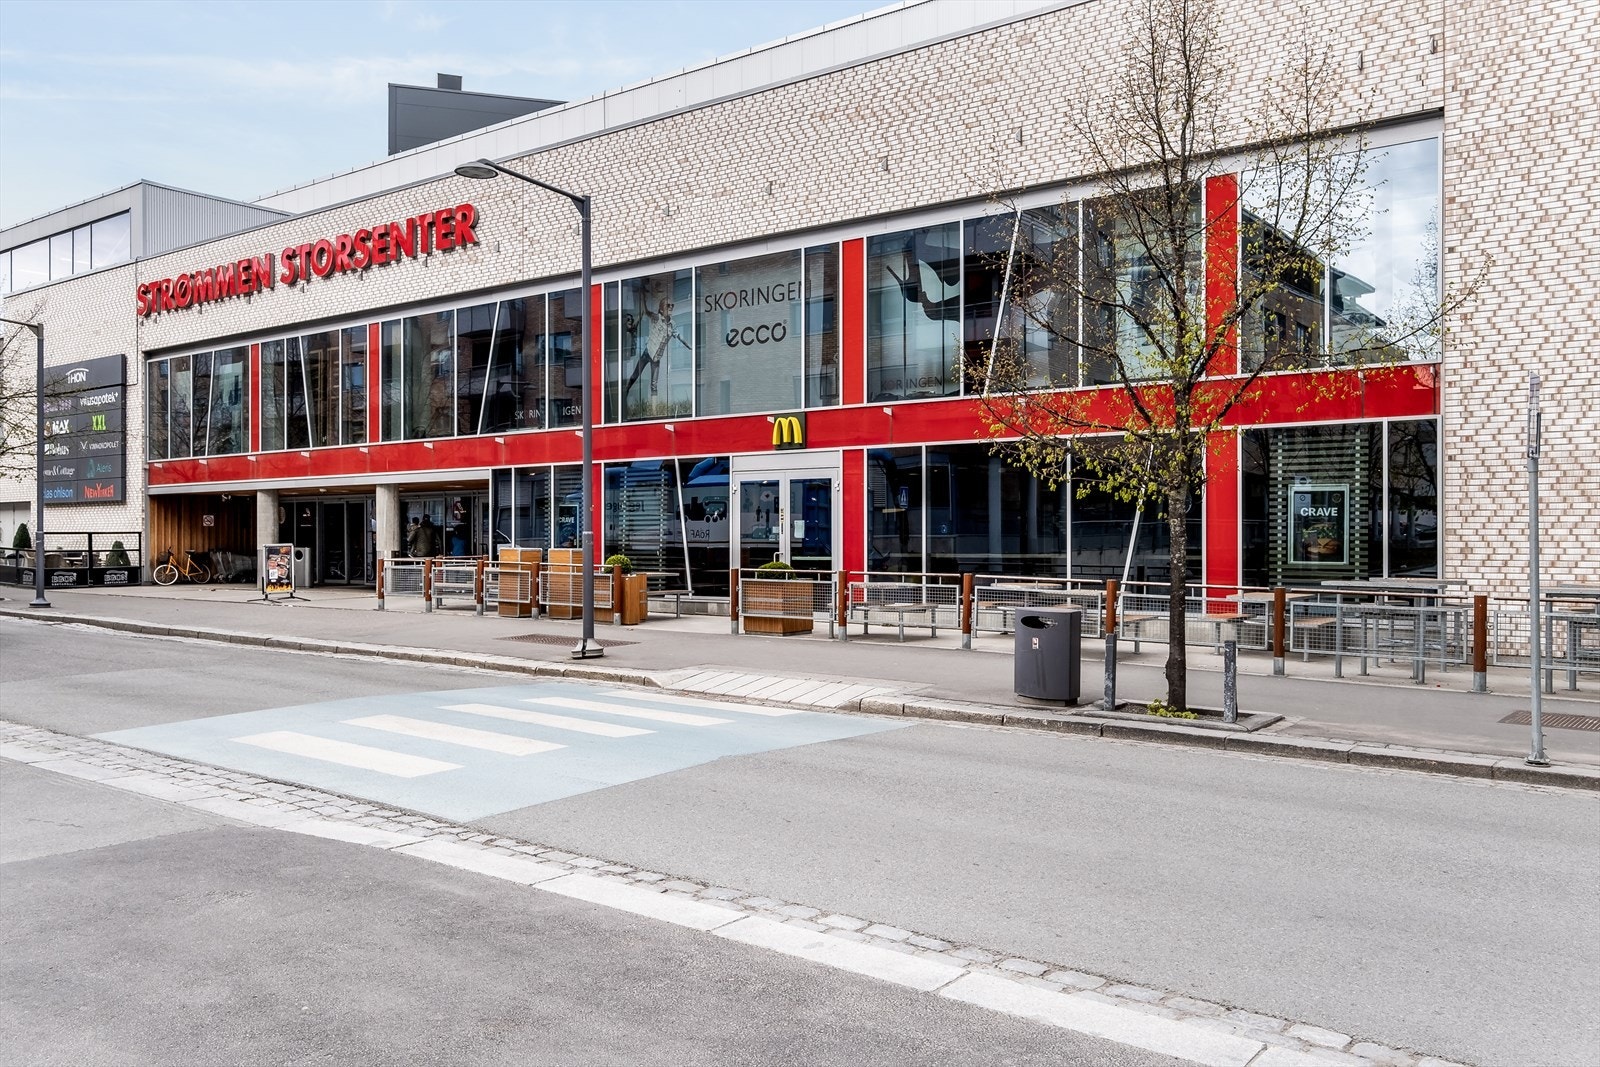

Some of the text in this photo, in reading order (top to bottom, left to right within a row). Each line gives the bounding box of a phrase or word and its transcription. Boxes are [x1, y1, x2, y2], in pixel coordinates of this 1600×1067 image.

[136, 203, 479, 317] STRØMMEN STORSENTER
[726, 322, 787, 348] ecco
[92, 414, 106, 431] XXL
[44, 487, 53, 498] las
[1300, 507, 1338, 517] CRAVE
